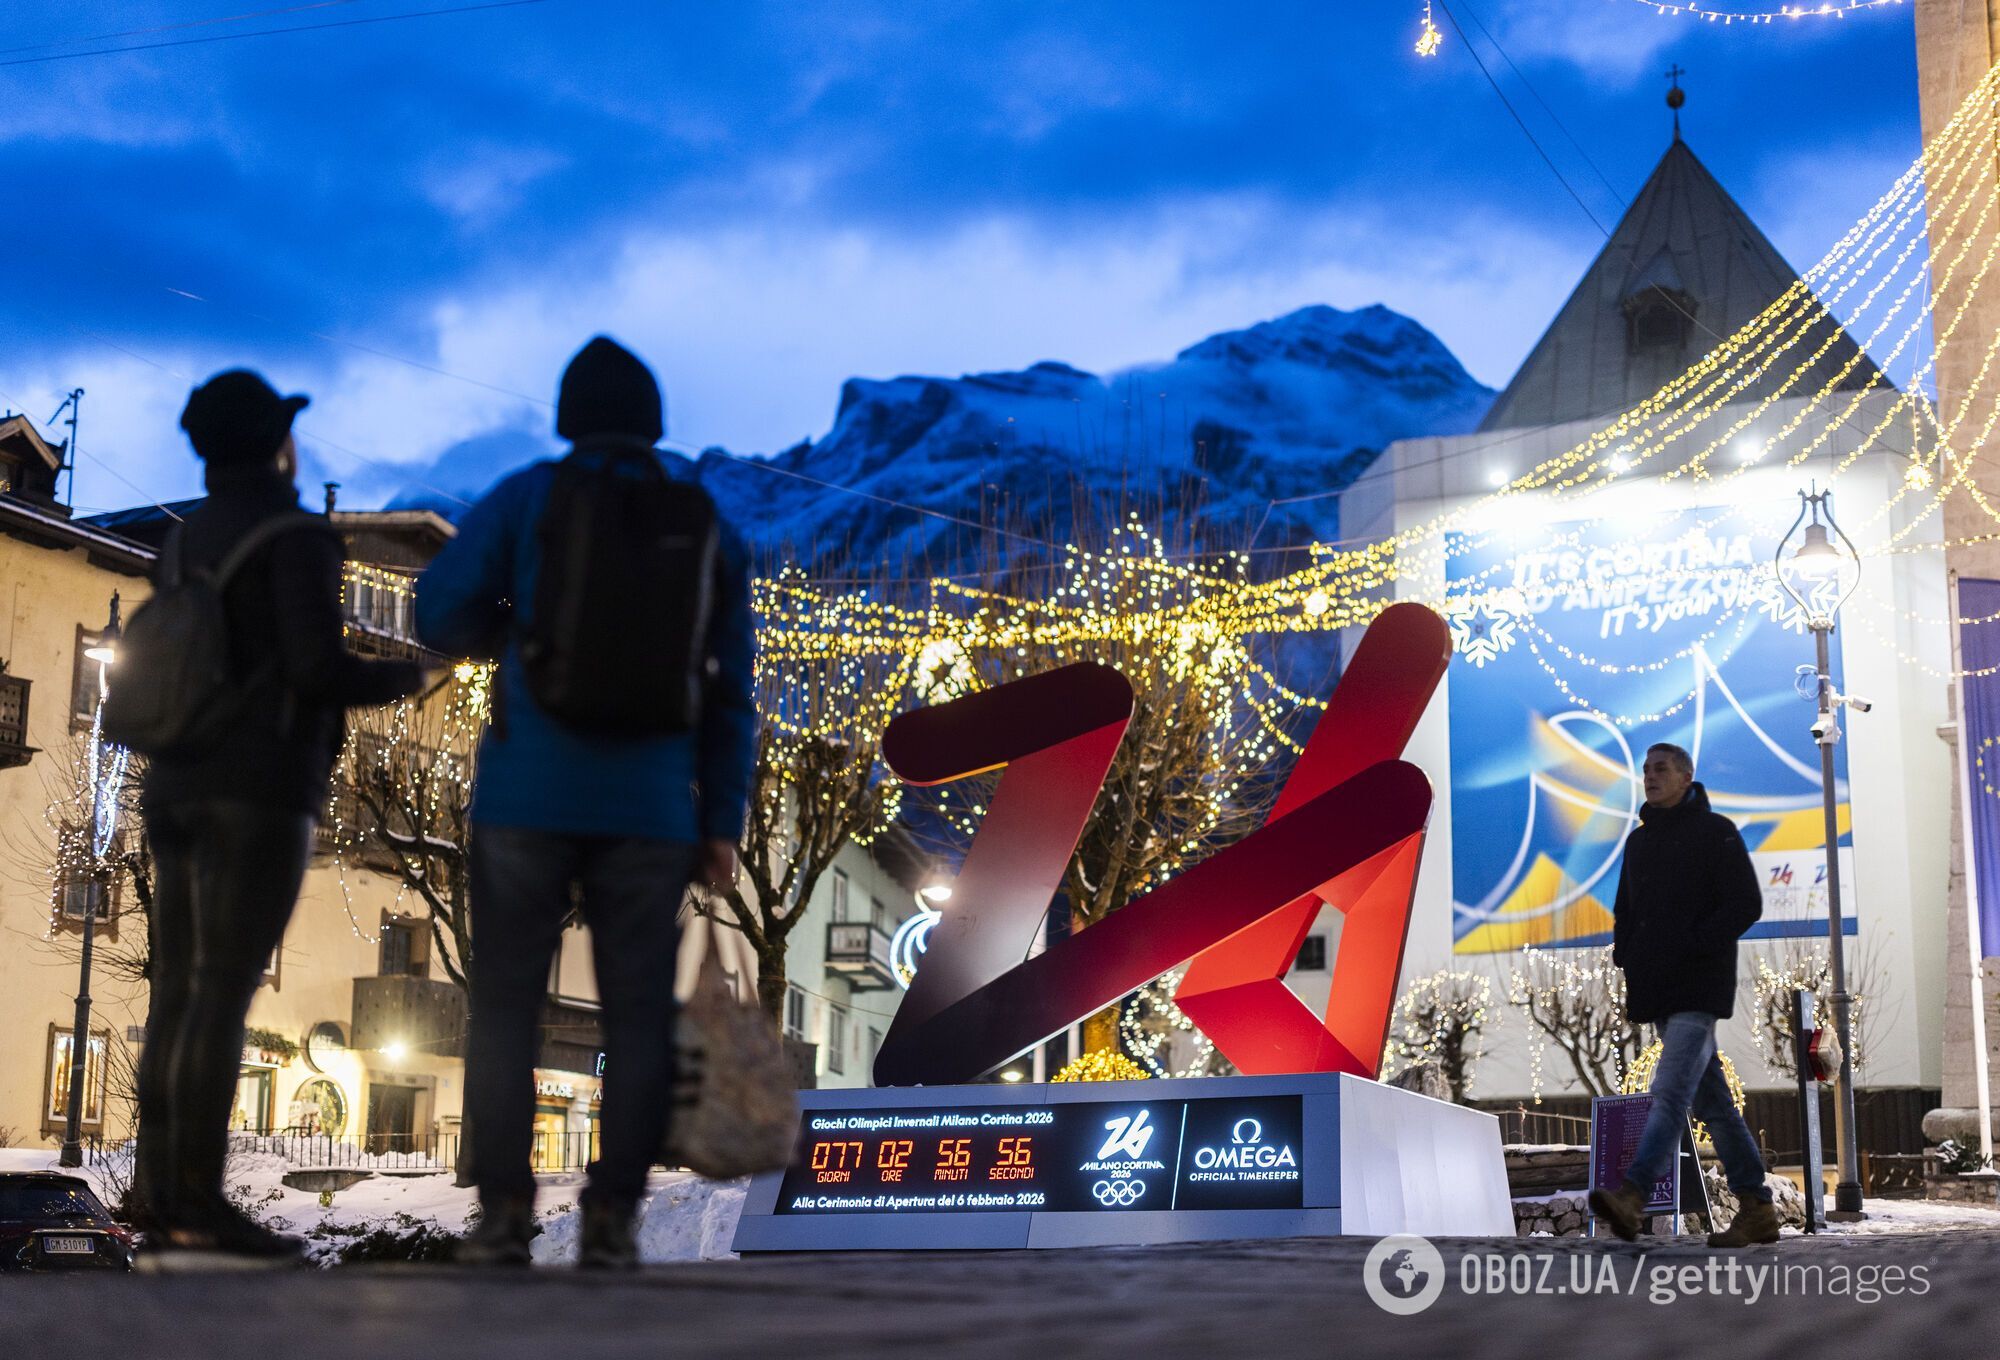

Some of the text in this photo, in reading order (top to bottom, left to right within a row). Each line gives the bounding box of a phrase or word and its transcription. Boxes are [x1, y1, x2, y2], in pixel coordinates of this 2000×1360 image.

[1514, 535, 1753, 588] IT'S CORTINA
[1651, 591, 1719, 633] your
[536, 1079, 574, 1098] HOUSE
[812, 1112, 1054, 1131] Giochi Olimpici Invernali Milano Cortina 2026
[811, 1137, 1032, 1169] 077 02 56 56
[1194, 1145, 1296, 1169] OMEGA
[816, 1167, 1035, 1183] GIORNI ORE MINUTI SECONDI
[1079, 1160, 1166, 1171] MILANO CORTINA
[1110, 1170, 1132, 1179] 2026
[1189, 1171, 1299, 1182] OFFICIAL TIMEKEEPER
[792, 1193, 1046, 1210] Alla Cerimonia di Apertura del 6 febbraio 2026
